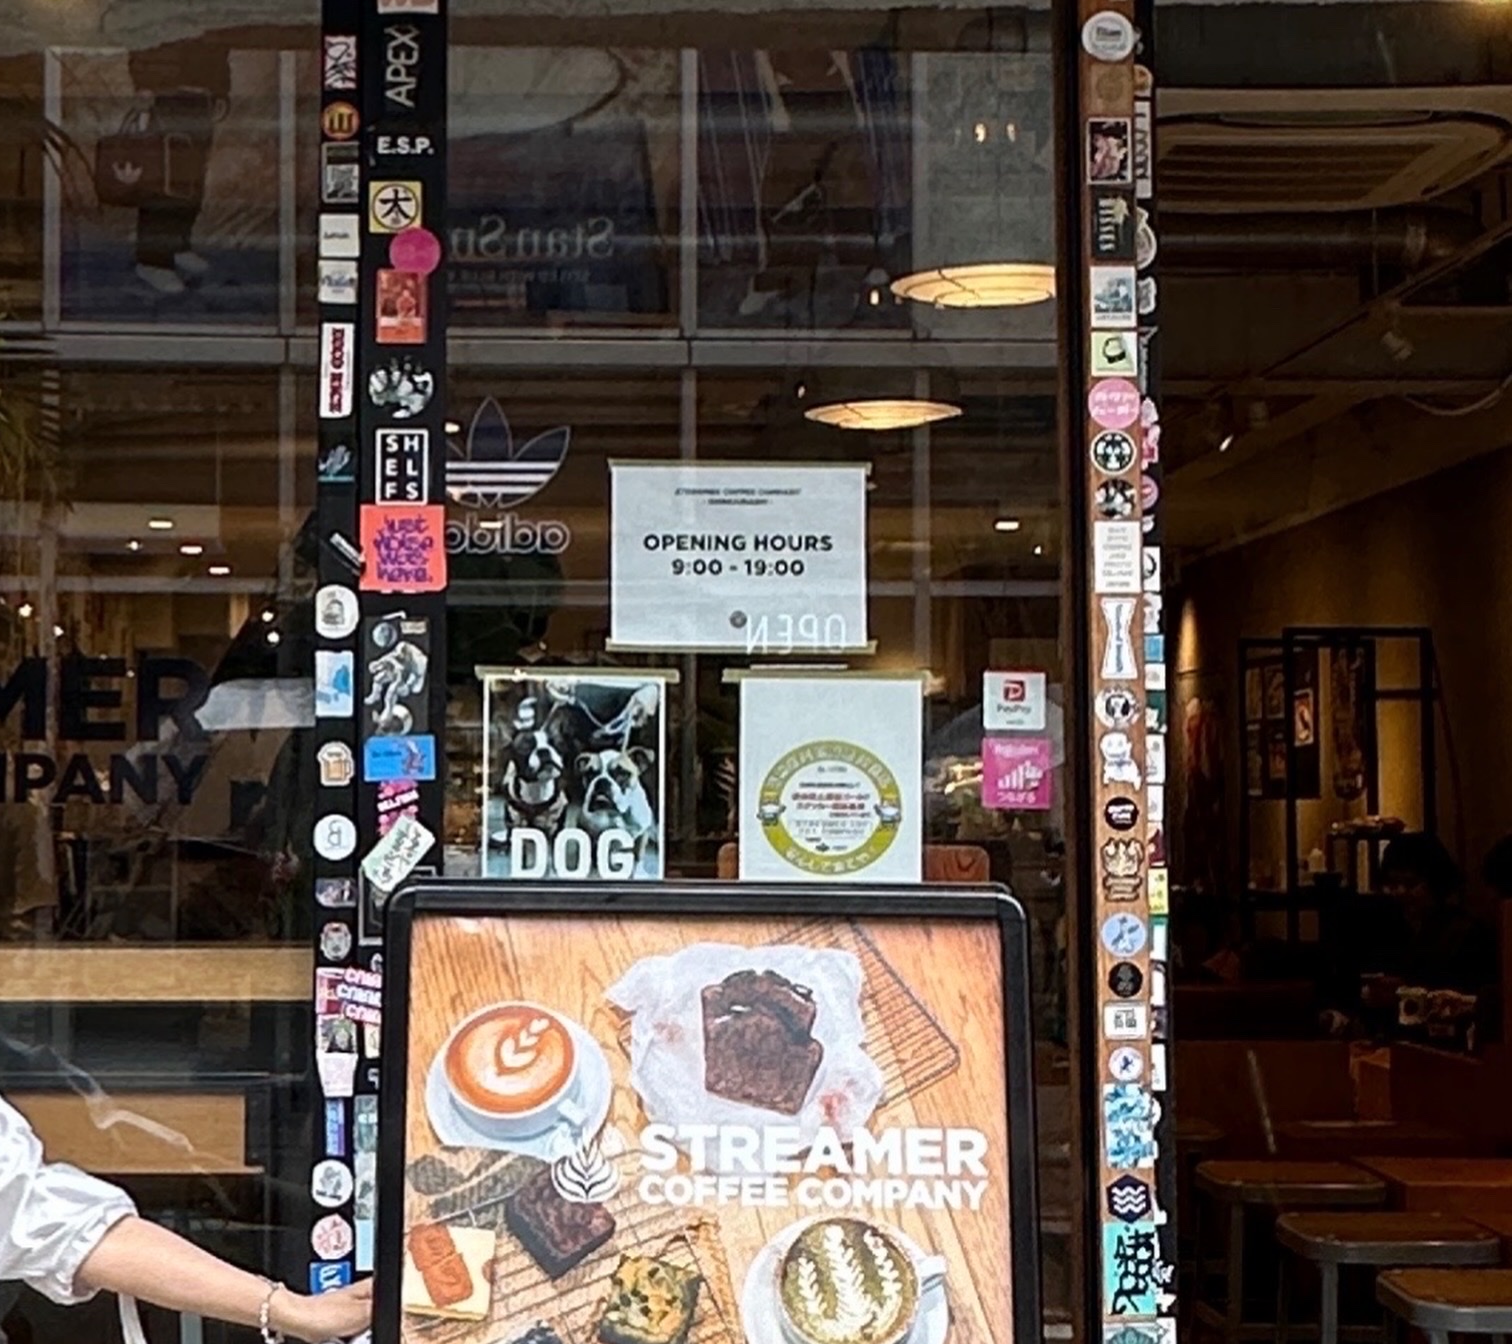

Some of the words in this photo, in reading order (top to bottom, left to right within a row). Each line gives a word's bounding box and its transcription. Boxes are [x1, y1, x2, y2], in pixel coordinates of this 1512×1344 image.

[384, 24, 421, 108] APEX
[377, 136, 434, 155] E.S.P.
[378, 188, 411, 222] 大
[643, 534, 747, 551] OPENING
[753, 534, 833, 552] HOURS
[671, 558, 723, 576] 9:00
[744, 558, 805, 576] 19:00
[511, 828, 636, 879] DOG
[638, 1122, 989, 1177] STREAMER
[638, 1174, 790, 1207] COFFEE
[797, 1176, 989, 1211] COMPANY
